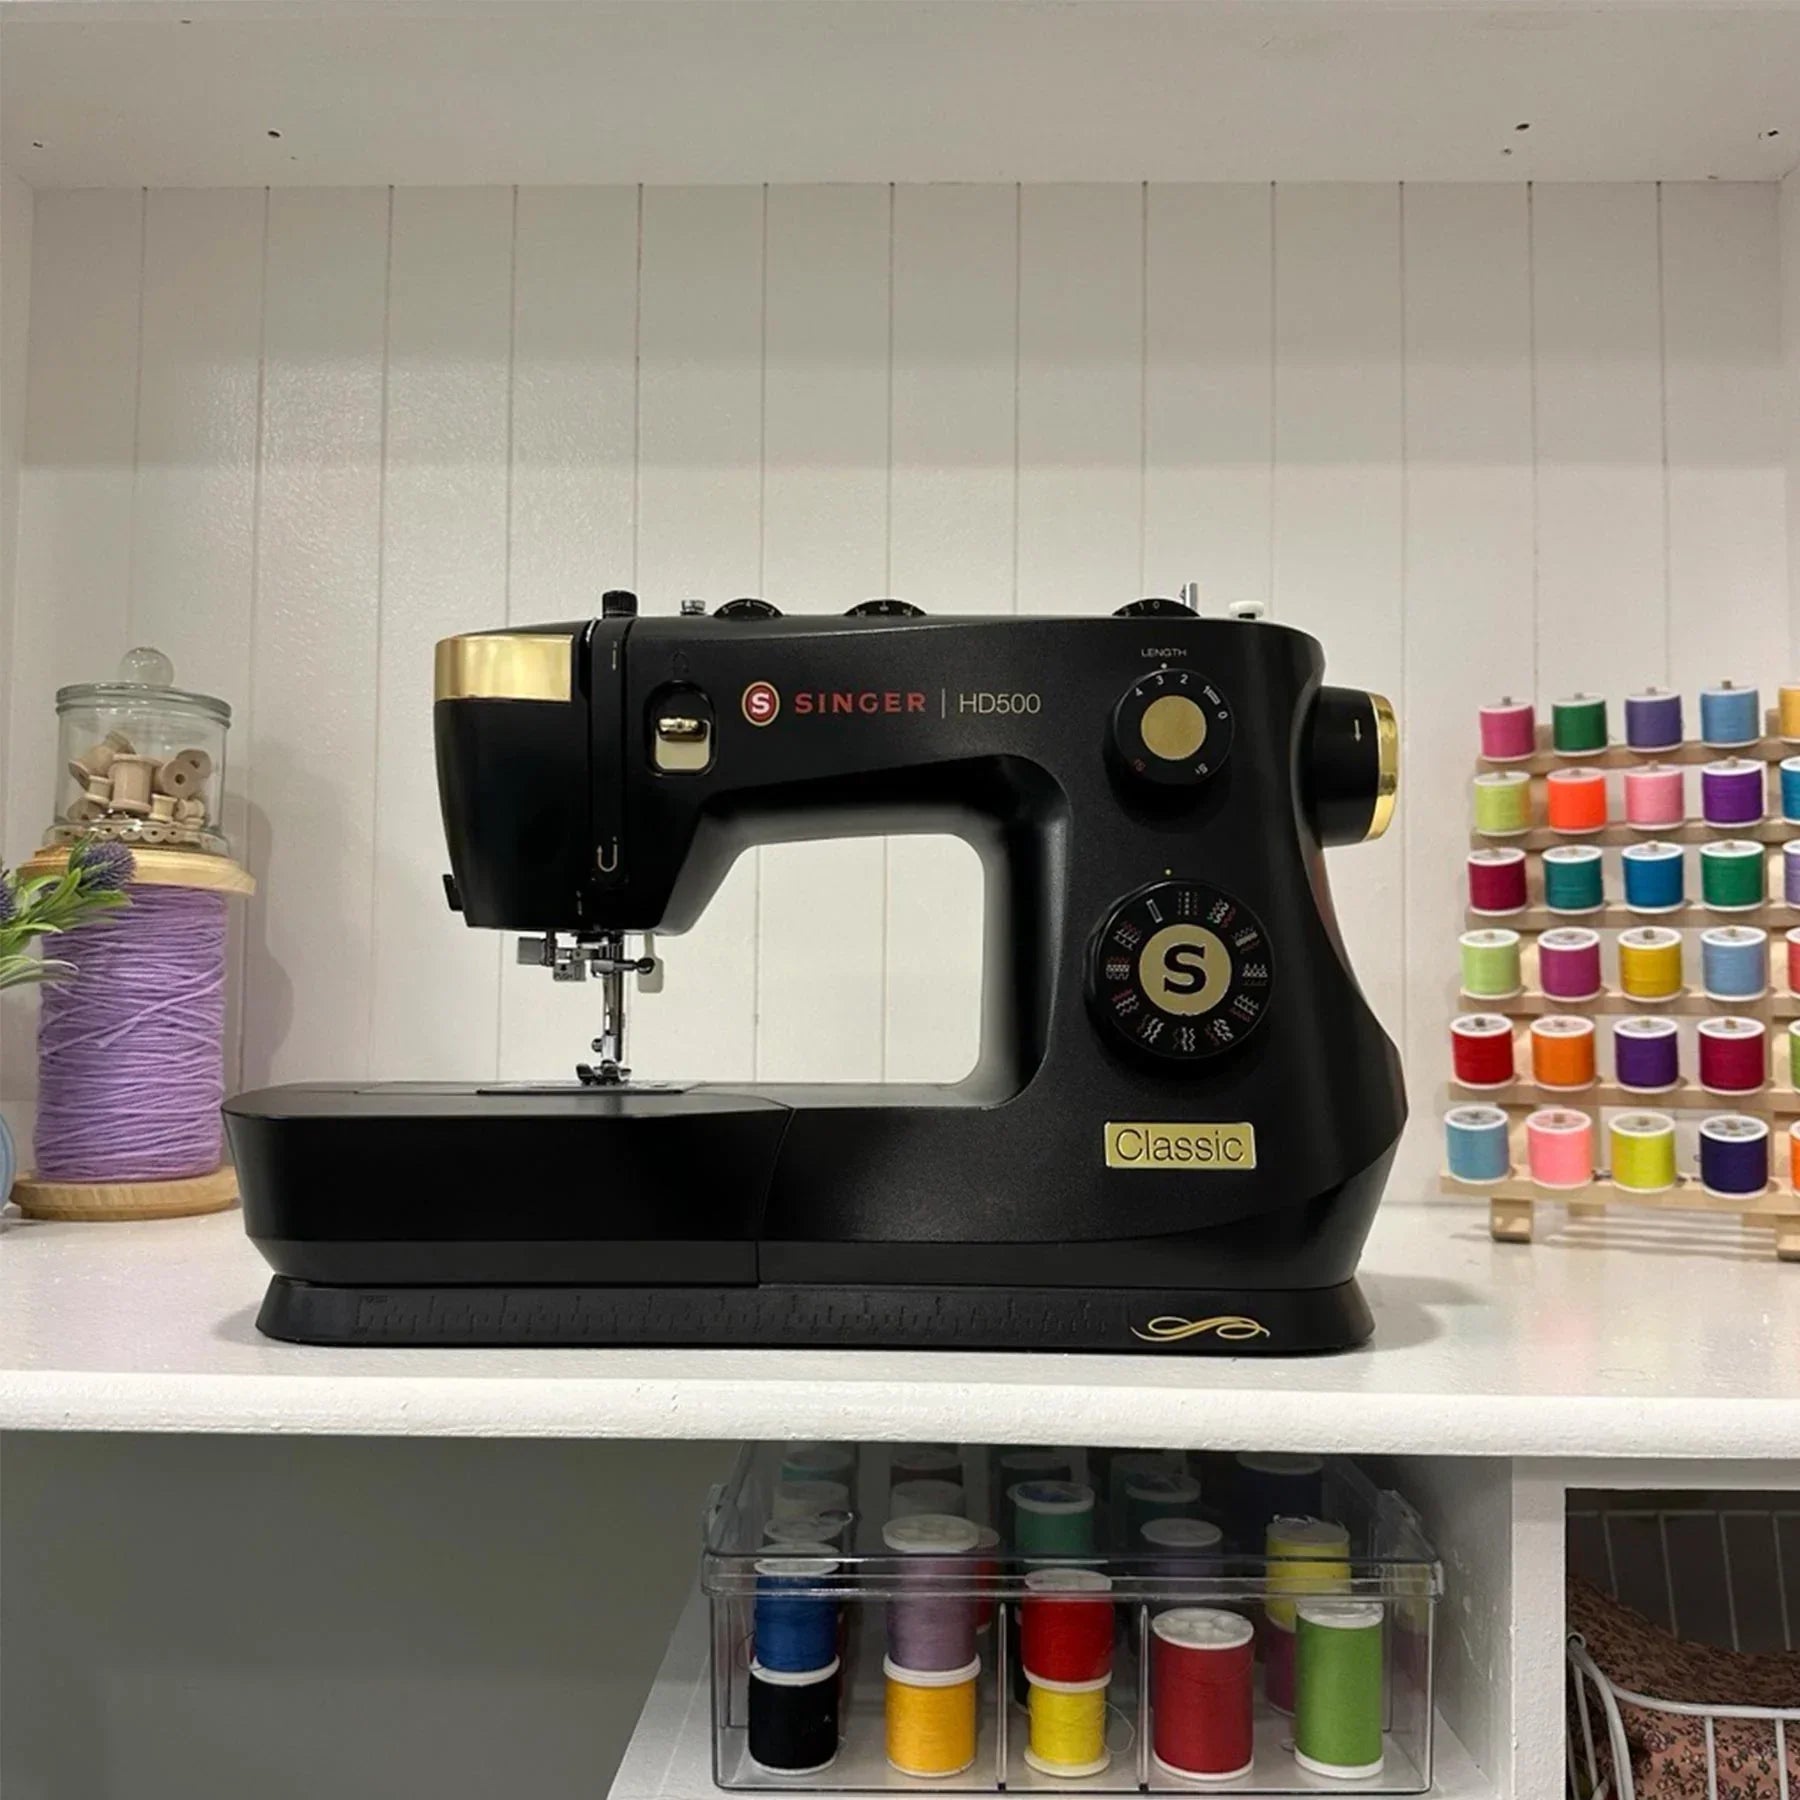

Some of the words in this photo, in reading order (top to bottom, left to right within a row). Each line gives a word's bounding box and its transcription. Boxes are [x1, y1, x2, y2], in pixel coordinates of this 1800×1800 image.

[1141, 648, 1187, 657] LENGTH
[752, 692, 770, 714] S
[795, 692, 926, 714] SINGER
[959, 692, 1041, 714] HD500
[1135, 687, 1143, 697] 4
[1156, 675, 1164, 685] 3
[1180, 674, 1189, 684] 2
[1218, 711, 1228, 719] 0
[1163, 943, 1208, 995] S
[1116, 1128, 1244, 1162] Classic
